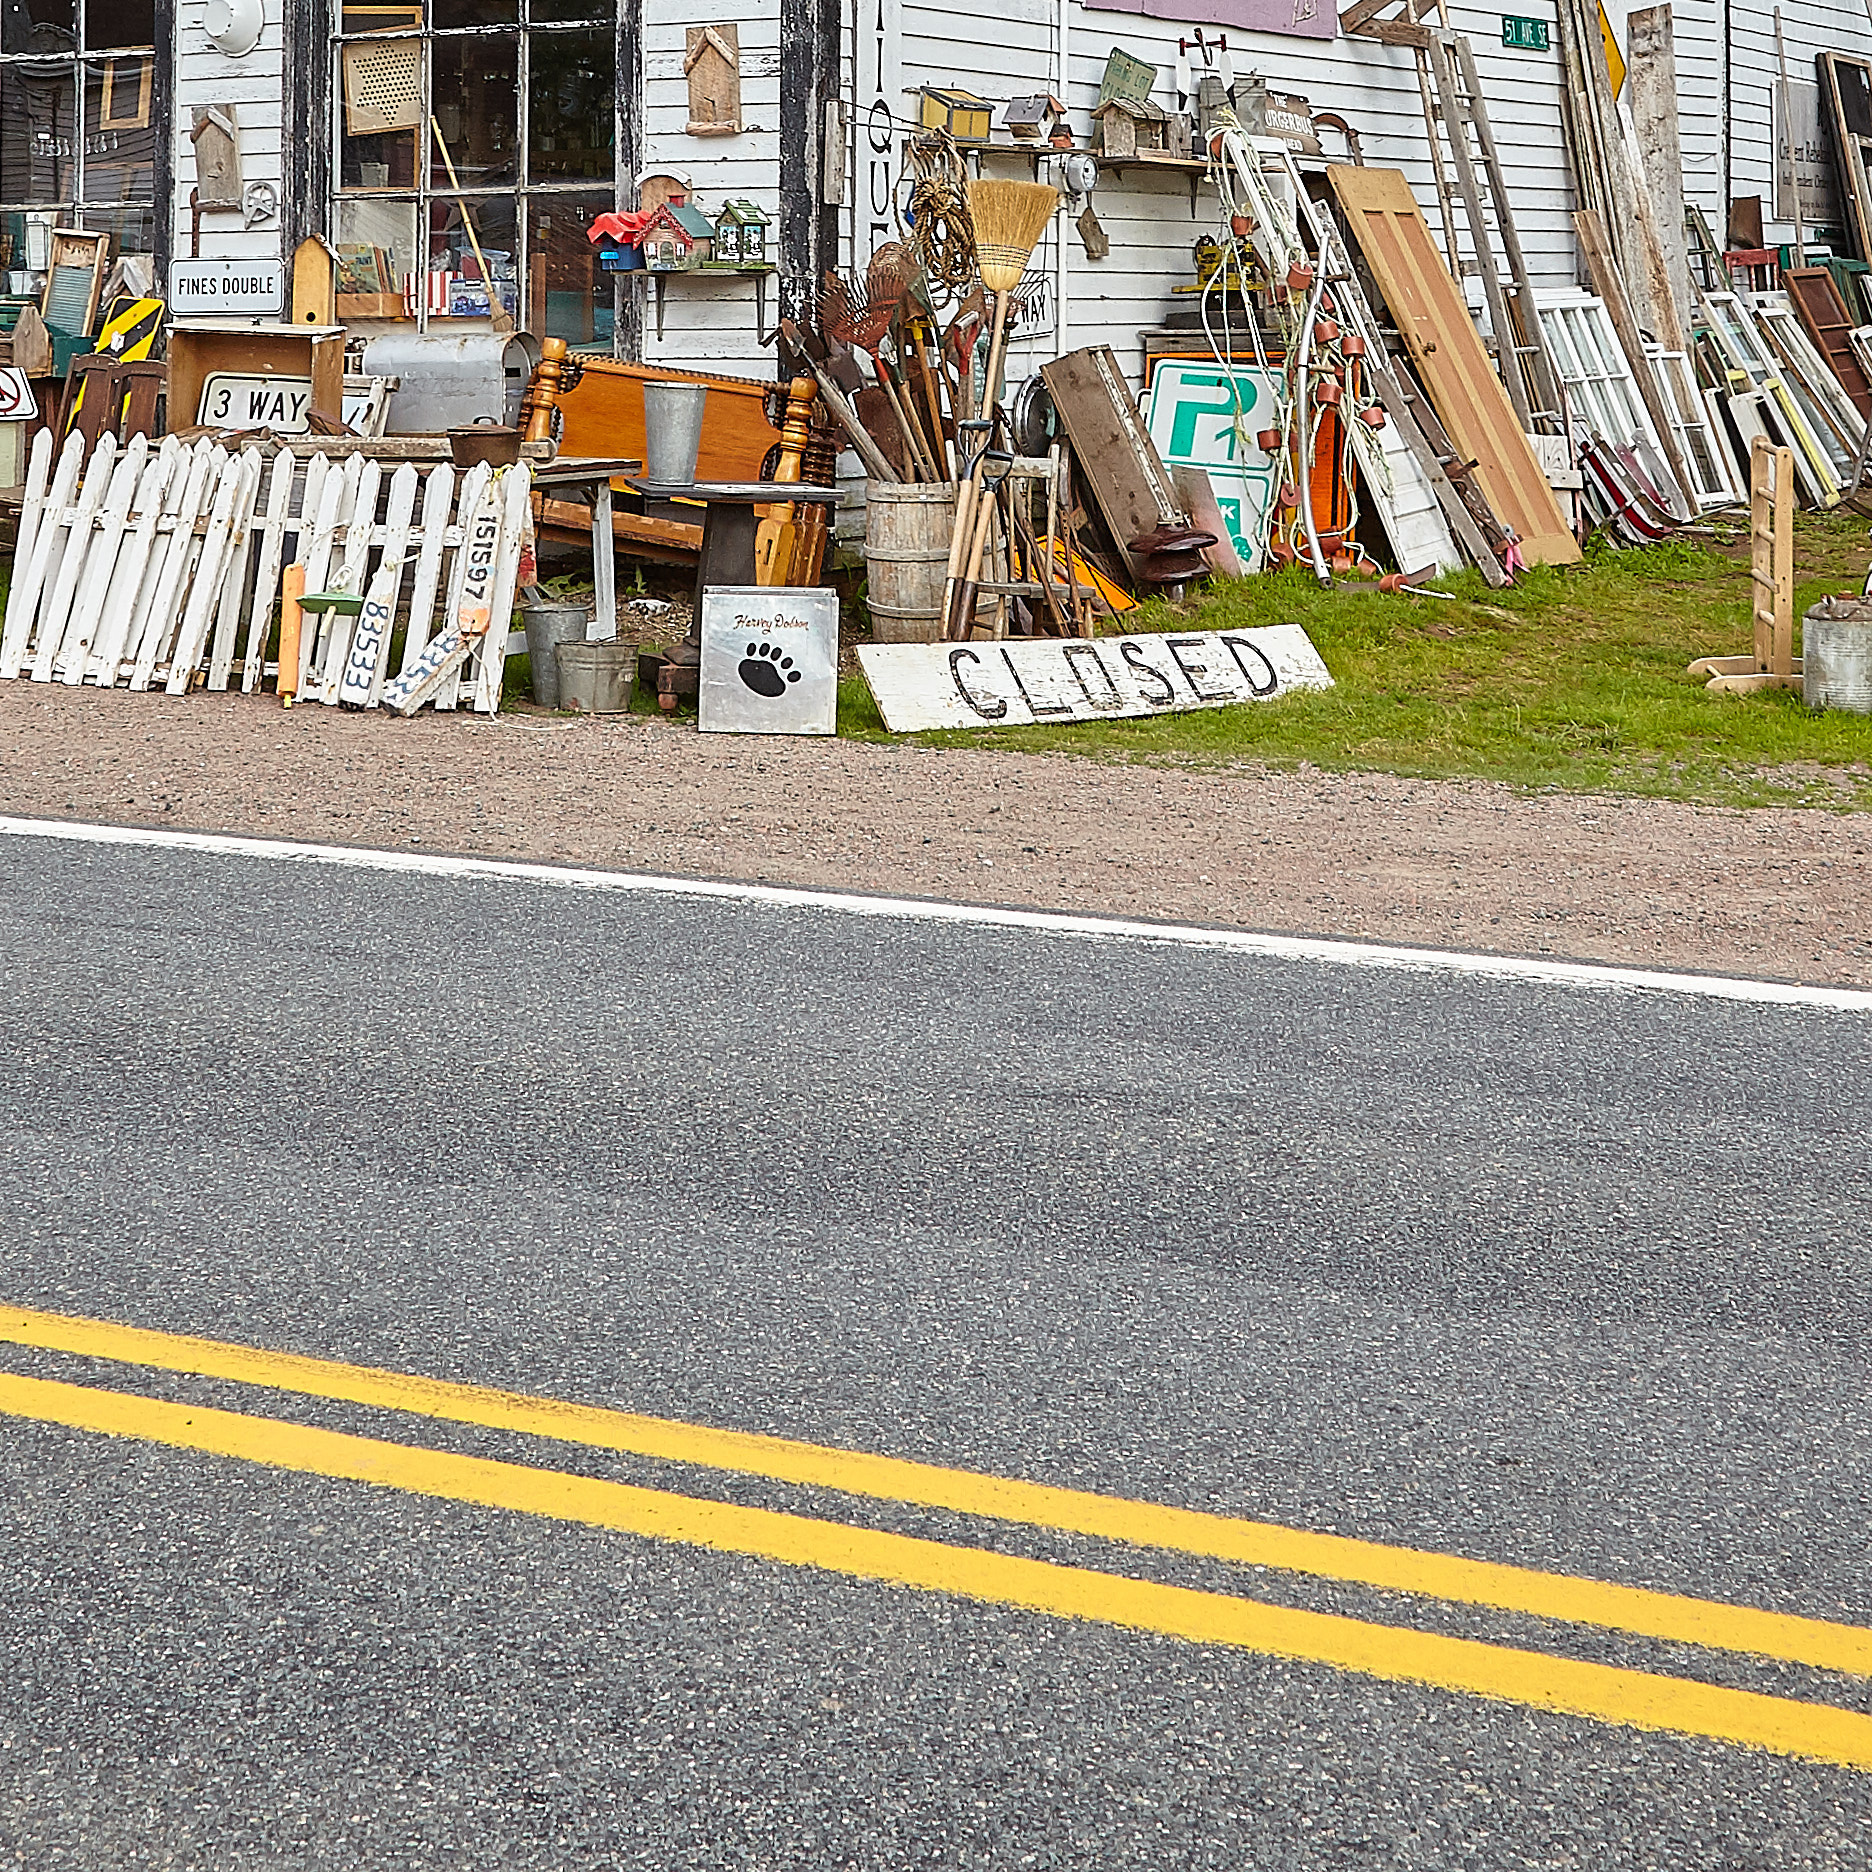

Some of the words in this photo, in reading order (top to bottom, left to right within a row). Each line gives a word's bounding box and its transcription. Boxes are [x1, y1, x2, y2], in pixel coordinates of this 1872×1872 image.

[178, 277, 217, 295] FINES
[222, 276, 275, 295] DOUBLE
[213, 389, 232, 419] 3
[248, 391, 308, 422] WAY
[465, 515, 497, 601] 151597
[345, 601, 389, 690] 83533
[948, 636, 1278, 720] CLOSED
